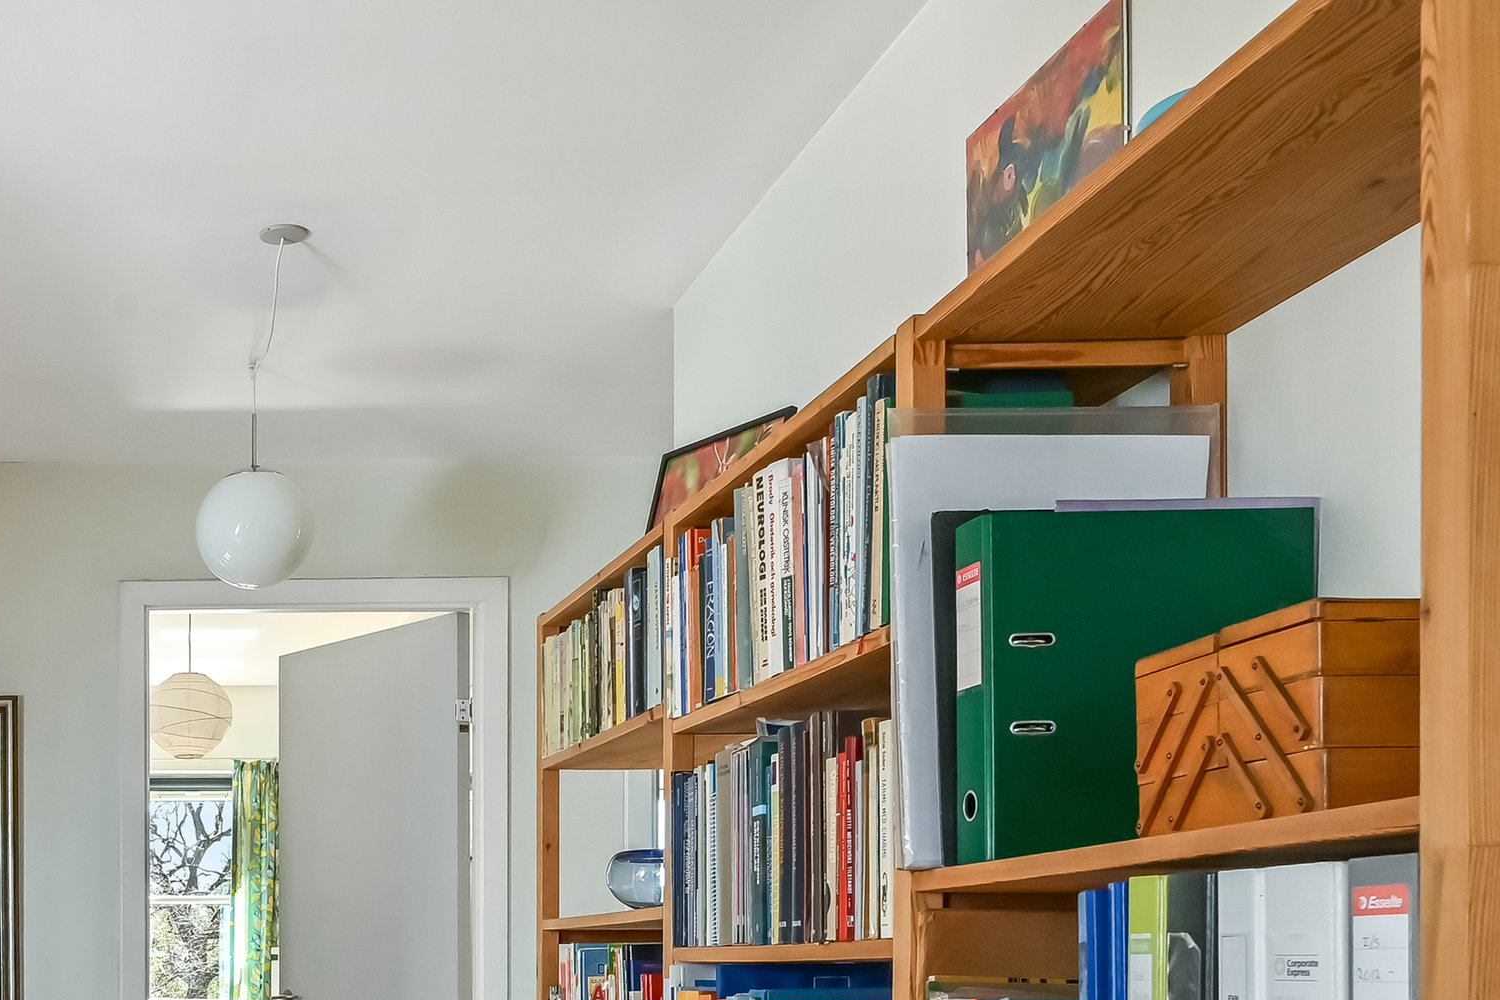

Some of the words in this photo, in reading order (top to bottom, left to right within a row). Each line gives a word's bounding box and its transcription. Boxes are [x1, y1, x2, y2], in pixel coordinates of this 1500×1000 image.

[781, 491, 789, 527] KLINISK
[756, 475, 767, 581] NEUROLOGI
[782, 528, 791, 574] OBSTETRIK
[962, 567, 979, 583] ESSELTE
[706, 581, 716, 659] ERAGON
[1368, 894, 1403, 909] Esselte
[1286, 959, 1319, 968] Corporate
[1286, 968, 1311, 977] Express
